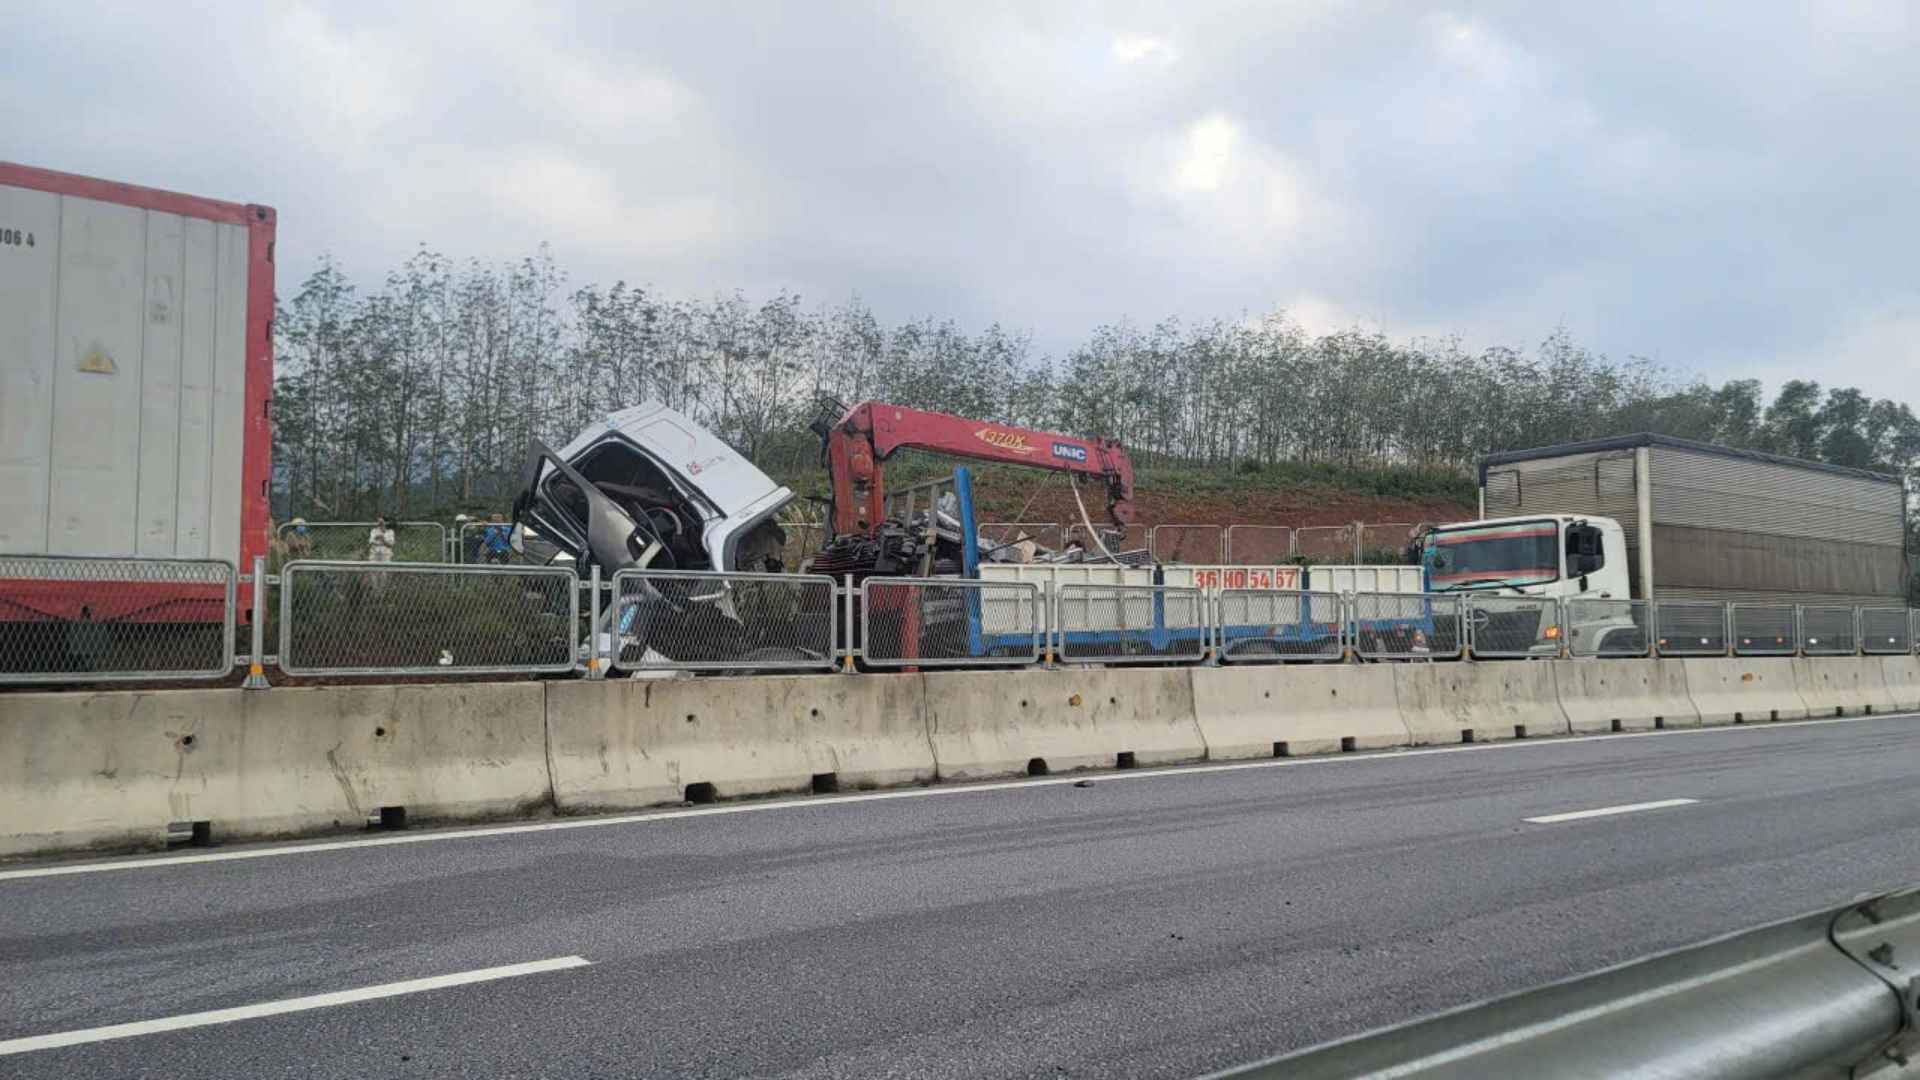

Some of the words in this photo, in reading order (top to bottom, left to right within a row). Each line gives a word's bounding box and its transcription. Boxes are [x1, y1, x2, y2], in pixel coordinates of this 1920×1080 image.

[0, 228, 22, 246] 06
[1053, 444, 1086, 460] UNIC
[1195, 570, 1217, 589] 36
[1250, 569, 1270, 589] 54
